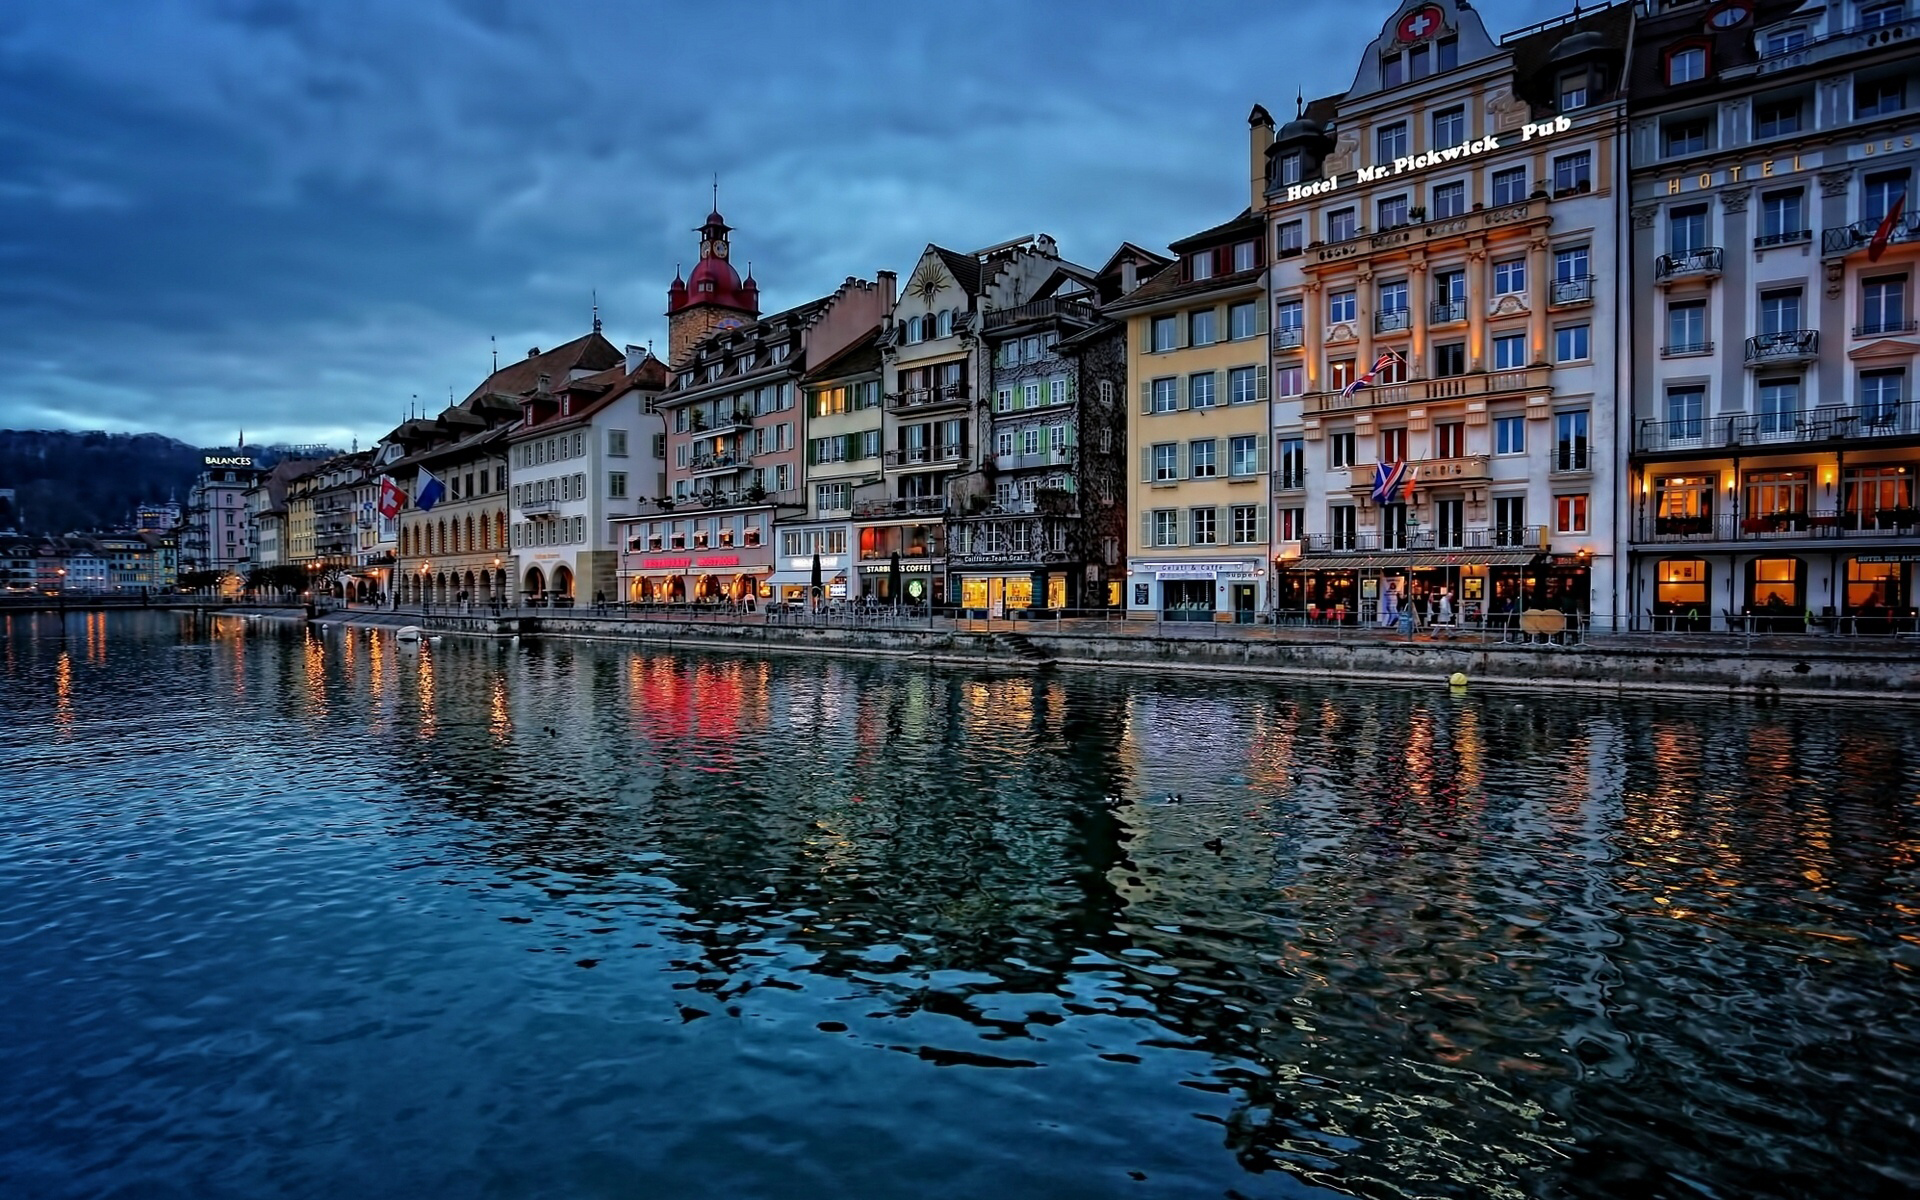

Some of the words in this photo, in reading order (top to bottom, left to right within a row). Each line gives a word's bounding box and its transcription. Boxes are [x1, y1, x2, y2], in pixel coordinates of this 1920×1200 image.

[1287, 175, 1338, 201] Hotel
[1356, 165, 1390, 184] Mr.
[1393, 134, 1500, 174] Pickwick
[1521, 115, 1571, 142] Pub
[1668, 155, 1805, 195] HOTEL
[1865, 135, 1912, 155] DES
[205, 456, 251, 466] BALANCES
